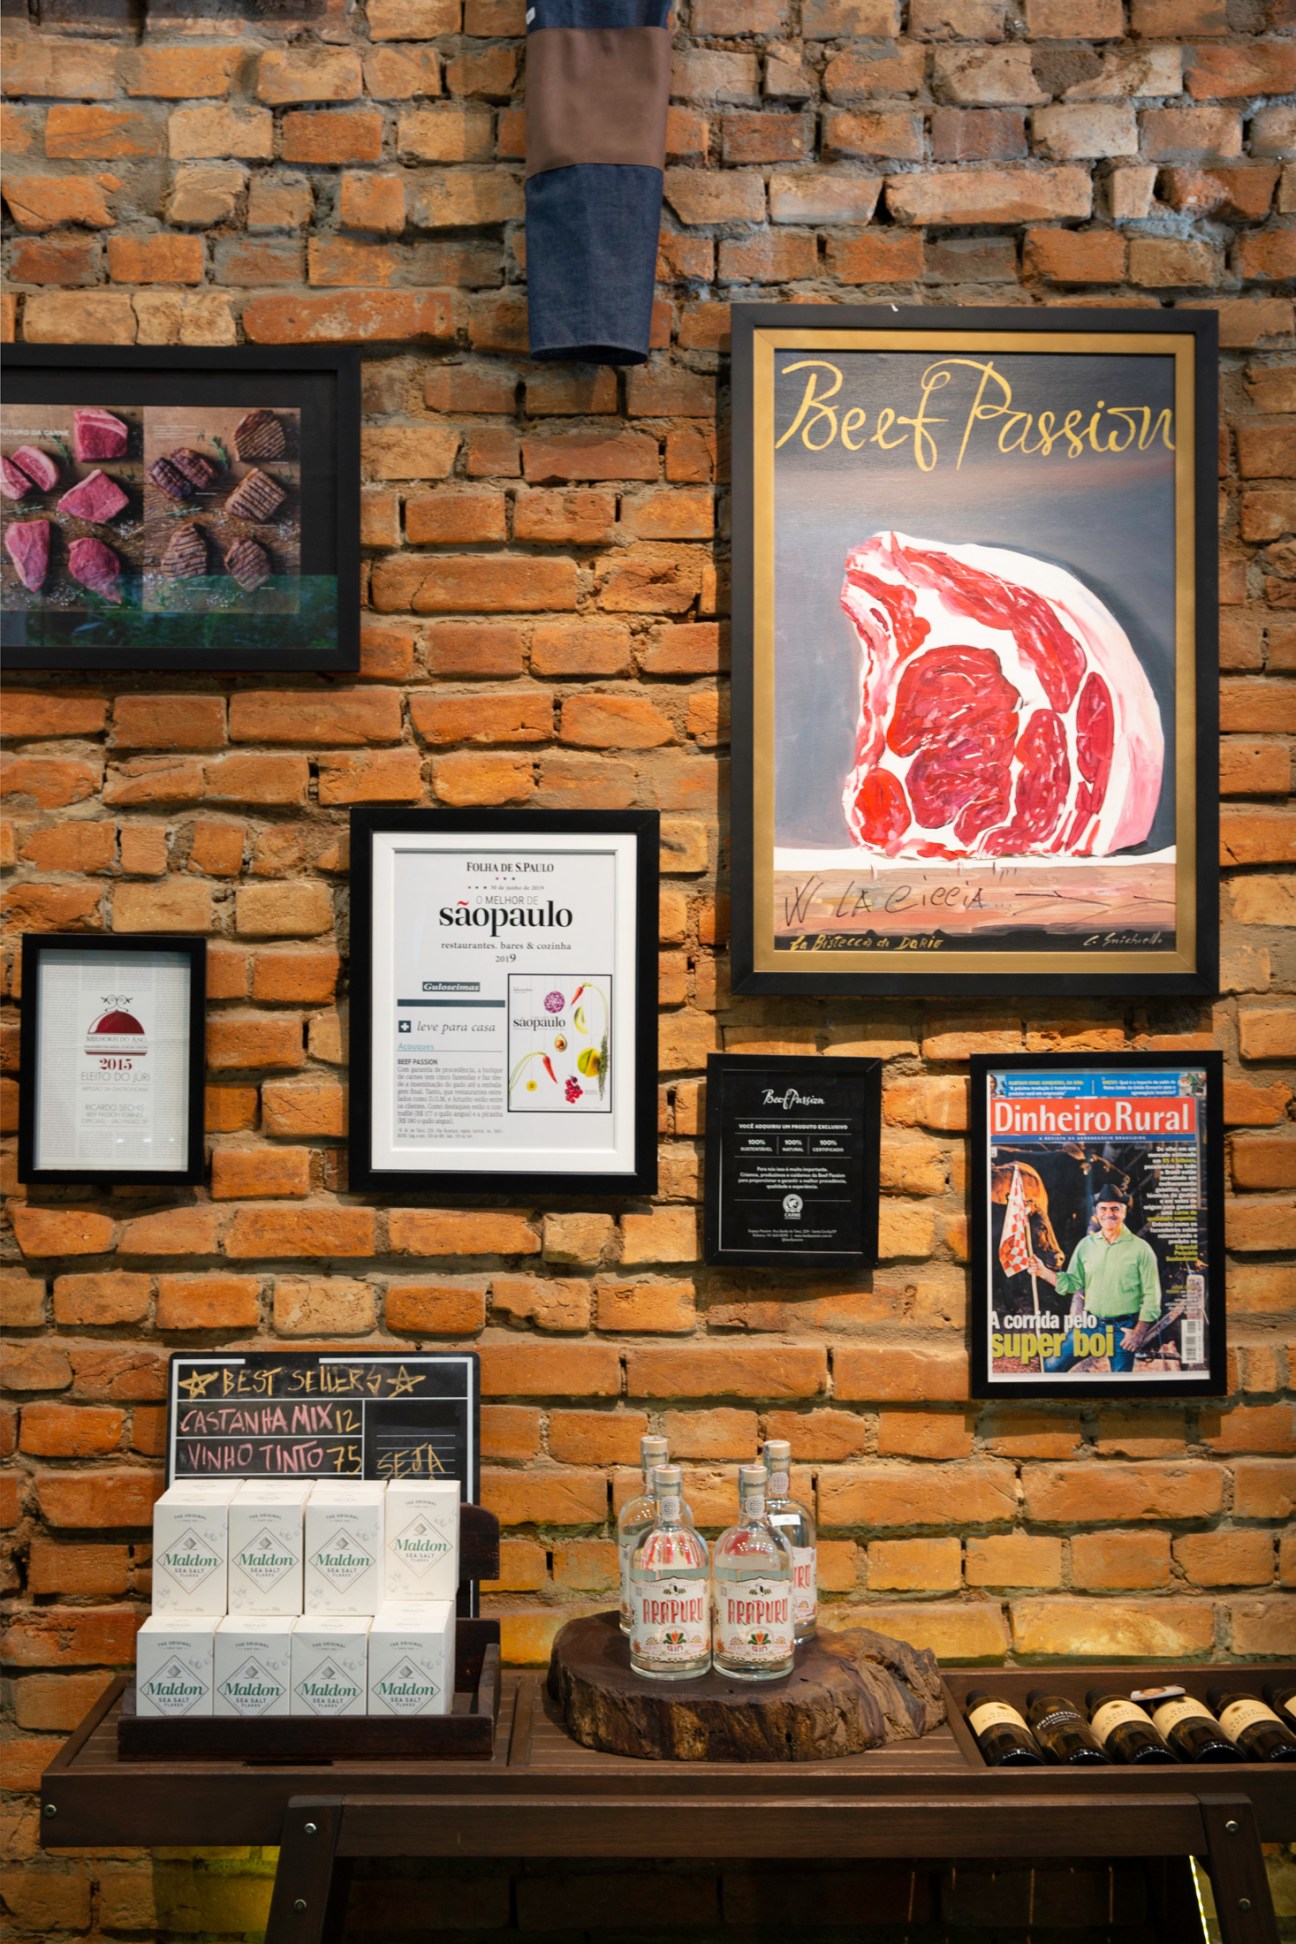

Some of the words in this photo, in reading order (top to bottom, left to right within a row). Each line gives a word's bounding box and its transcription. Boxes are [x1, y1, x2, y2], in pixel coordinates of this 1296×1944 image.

[775, 359, 952, 471] Beef
[940, 359, 1176, 471] Passion
[466, 861, 499, 872] FOLHA
[501, 863, 512, 872] DE
[515, 862, 555, 873] S.PAULO
[485, 895, 525, 905] MELHOR
[527, 896, 539, 905] DE
[438, 899, 573, 938] sãopaulo
[500, 941, 524, 950] bares
[526, 942, 534, 950] &
[536, 942, 572, 950] cozinha
[495, 953, 517, 963] 2019
[423, 982, 480, 991] Guloseimas
[417, 1020, 439, 1032] leve
[441, 1023, 469, 1035] para
[471, 1023, 496, 1032] casa
[99, 1058, 133, 1070] 2015
[114, 1072, 130, 1081] DO
[994, 1101, 1112, 1132] Dinheiro
[1115, 1101, 1190, 1132] Rural
[990, 1310, 1001, 1329] A
[1003, 1310, 1060, 1329] corrida
[1063, 1310, 1098, 1335] pelo
[991, 1333, 1067, 1364] super
[1073, 1325, 1114, 1357] boi
[222, 1367, 283, 1397] BEST
[179, 1406, 289, 1435] CASTANHA
[290, 1403, 333, 1434] MIX
[335, 1409, 361, 1434] 12
[187, 1443, 254, 1471] VINHO
[258, 1441, 324, 1473] TINTO
[326, 1445, 363, 1475] 75
[394, 1538, 449, 1553] Maldon
[163, 1552, 218, 1567] Maldon
[238, 1552, 294, 1567] Maldon
[315, 1552, 371, 1567] Maldon
[174, 1567, 189, 1575] SEA
[147, 1681, 204, 1697] Maldon
[224, 1682, 281, 1697] Maldon
[301, 1682, 359, 1698] Maldon
[379, 1681, 436, 1697] Maldon
[312, 1697, 326, 1705] SEA
